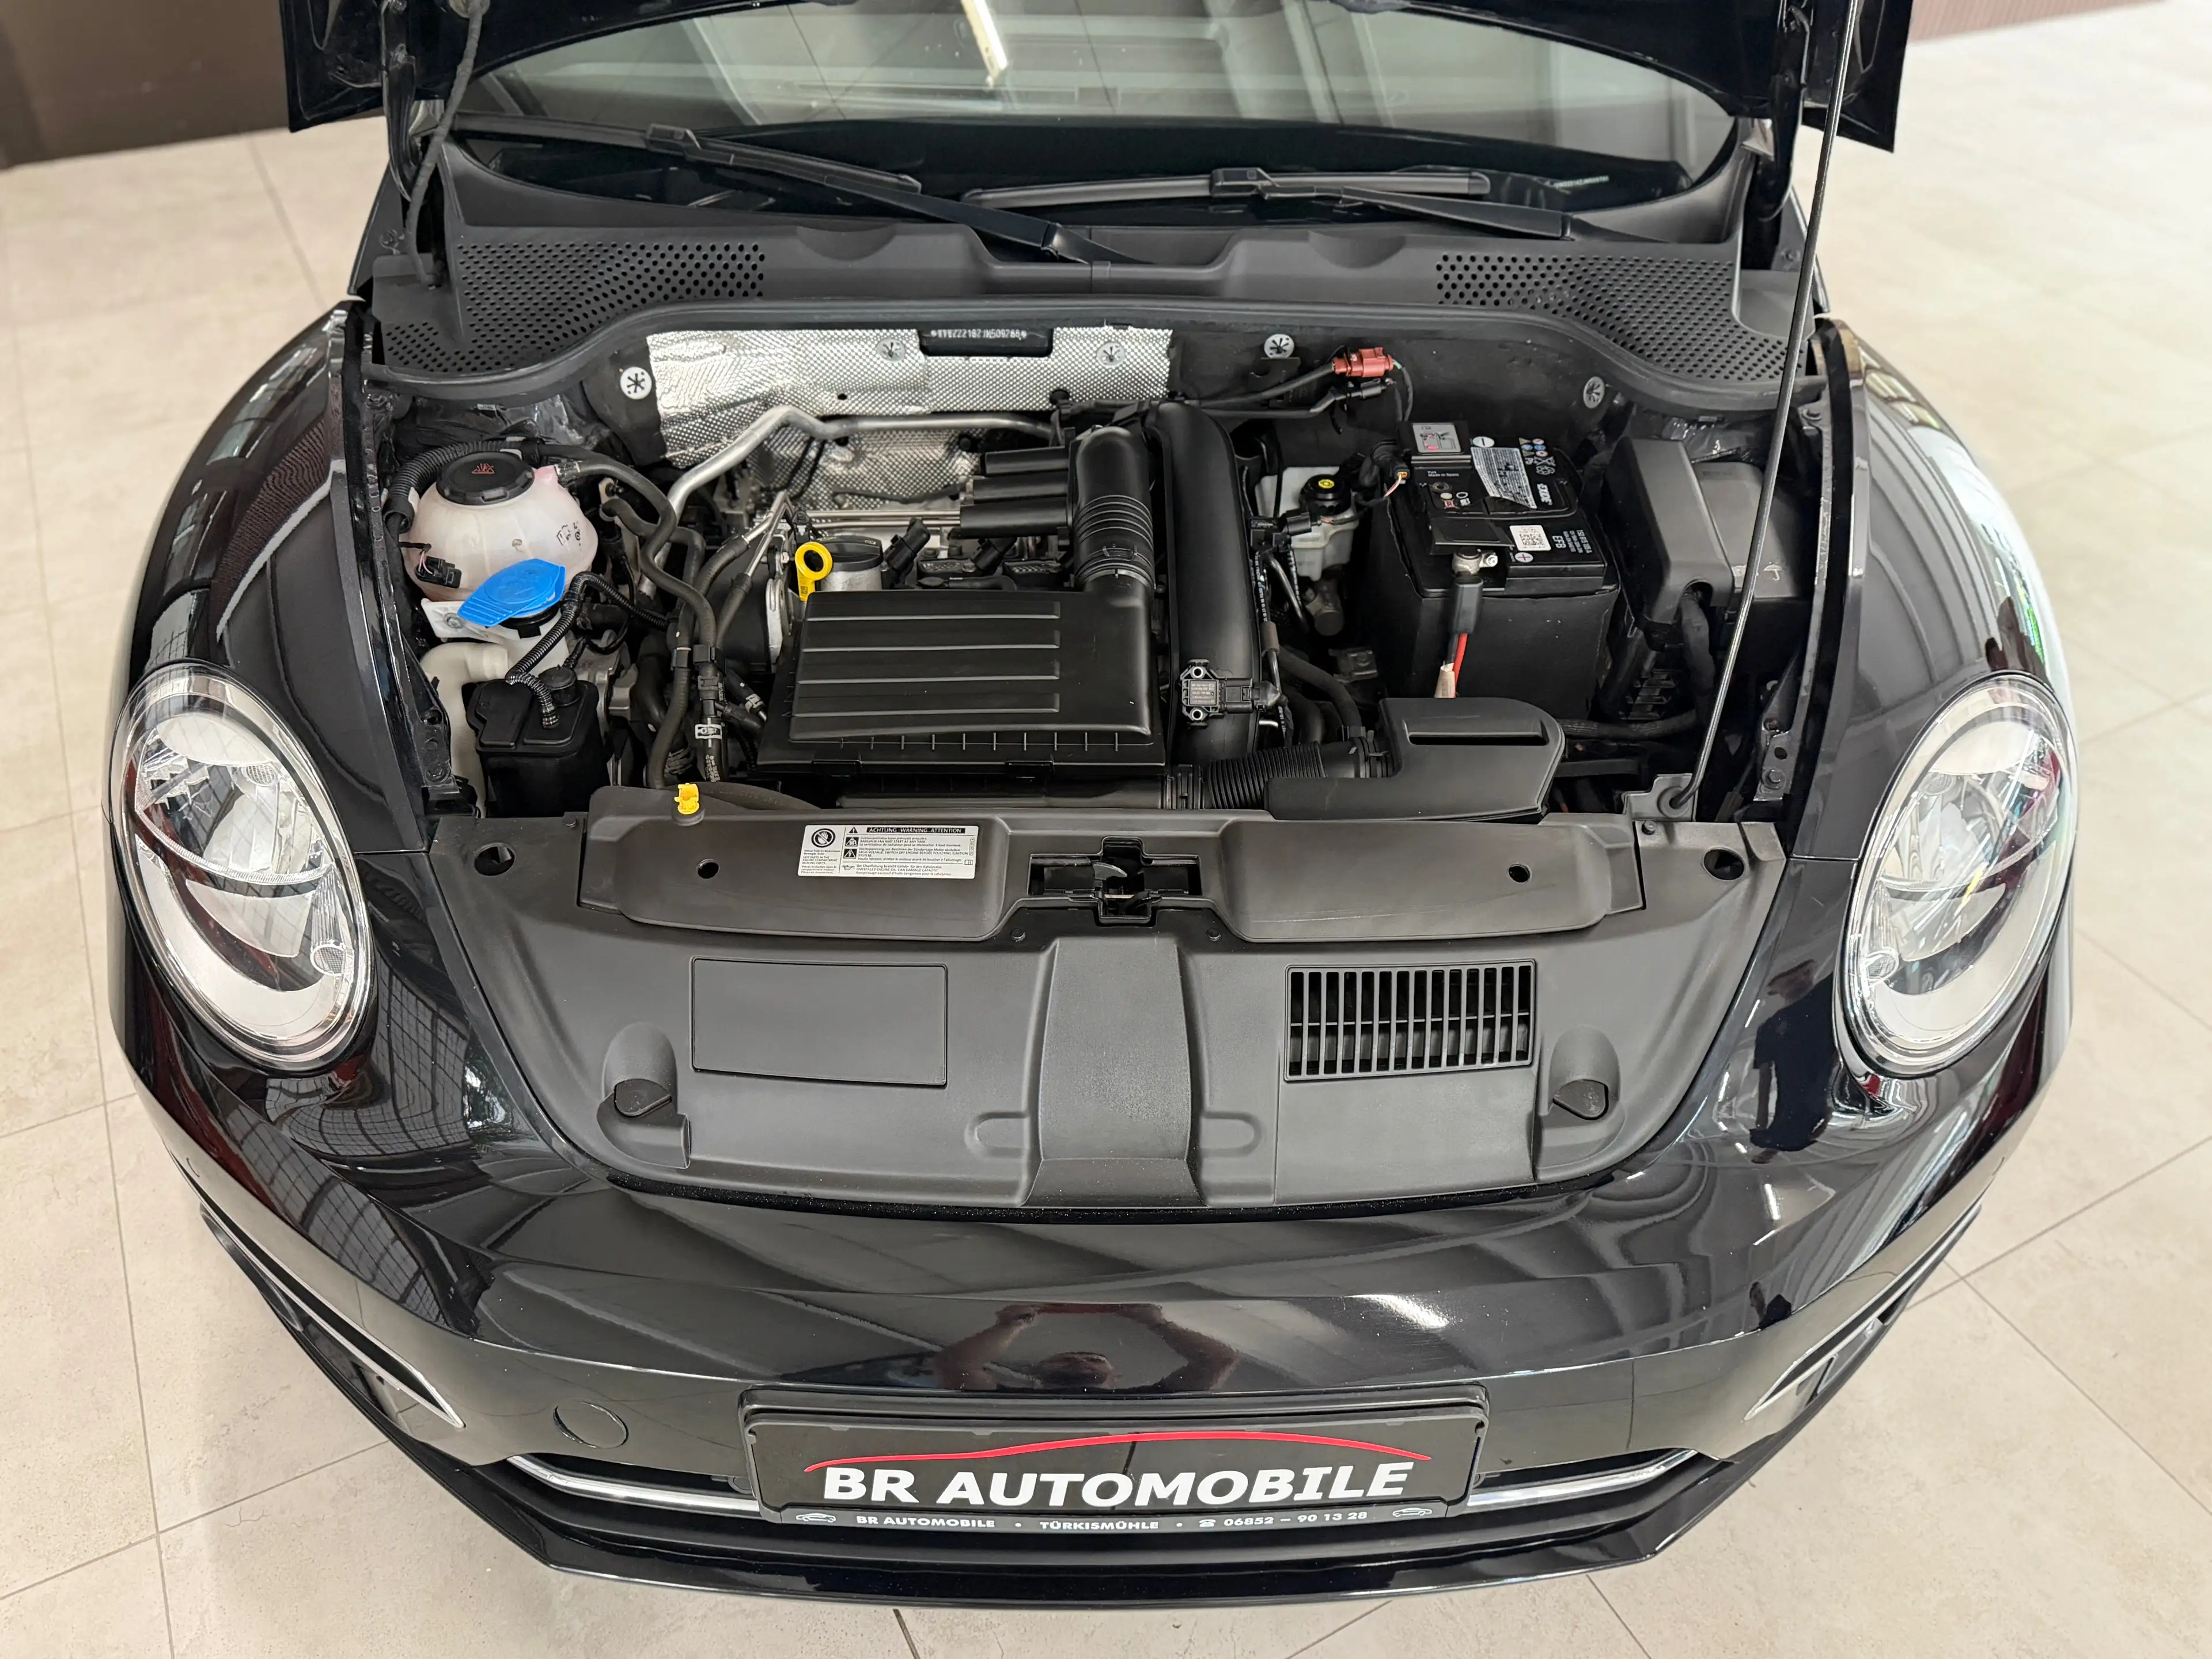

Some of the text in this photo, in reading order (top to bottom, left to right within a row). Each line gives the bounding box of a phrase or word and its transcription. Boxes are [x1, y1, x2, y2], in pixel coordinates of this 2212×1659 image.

[1552, 535, 1567, 548] EFB
[823, 1461, 1414, 1507] BR AUTOMOBILE
[857, 1516, 879, 1525] BR
[883, 1516, 996, 1528] AUTOMOBILE
[1040, 1520, 1160, 1531] TÜRKISMÜHLE
[1224, 1516, 1274, 1527] 06852
[1297, 1514, 1318, 1523] 90
[1324, 1513, 1343, 1522] 13
[1347, 1512, 1368, 1521] 28
